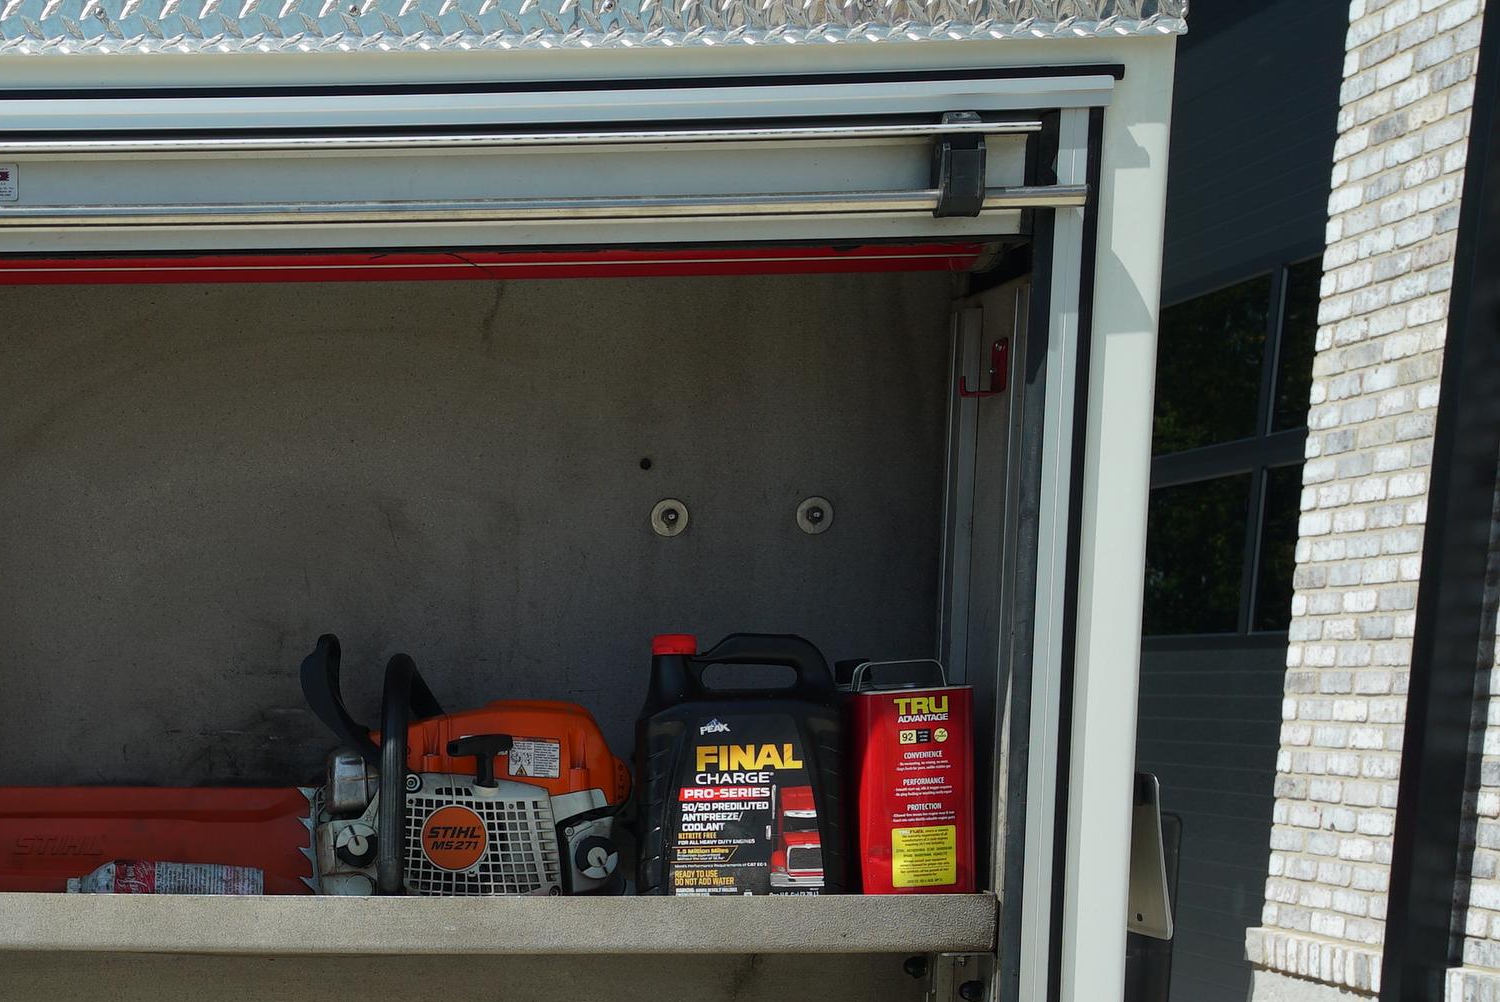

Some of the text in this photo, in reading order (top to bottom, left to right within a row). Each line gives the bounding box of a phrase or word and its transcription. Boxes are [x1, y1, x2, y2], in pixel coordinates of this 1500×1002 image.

[894, 696, 948, 715] TRU
[898, 713, 948, 723] ADVANTAGE
[700, 722, 731, 736] PEAK
[902, 732, 913, 742] 92
[696, 743, 803, 772] FINAL
[903, 750, 942, 760] CONVENIENCE
[695, 772, 770, 785] CHARGE
[903, 777, 944, 786] PERFORMANCE
[684, 787, 771, 799] PRO-SERIES
[682, 801, 769, 812] 50/50 PREDILUTED
[907, 802, 941, 811] PROTECTION
[682, 812, 743, 822] ANTIFREEZE/
[682, 822, 725, 832] COOLANT
[428, 826, 481, 839] STIHL
[678, 832, 701, 840] NITRITE
[706, 869, 718, 877] USE
[675, 878, 683, 886] DO
[698, 877, 711, 885] ADD
[712, 877, 735, 885] WATER
